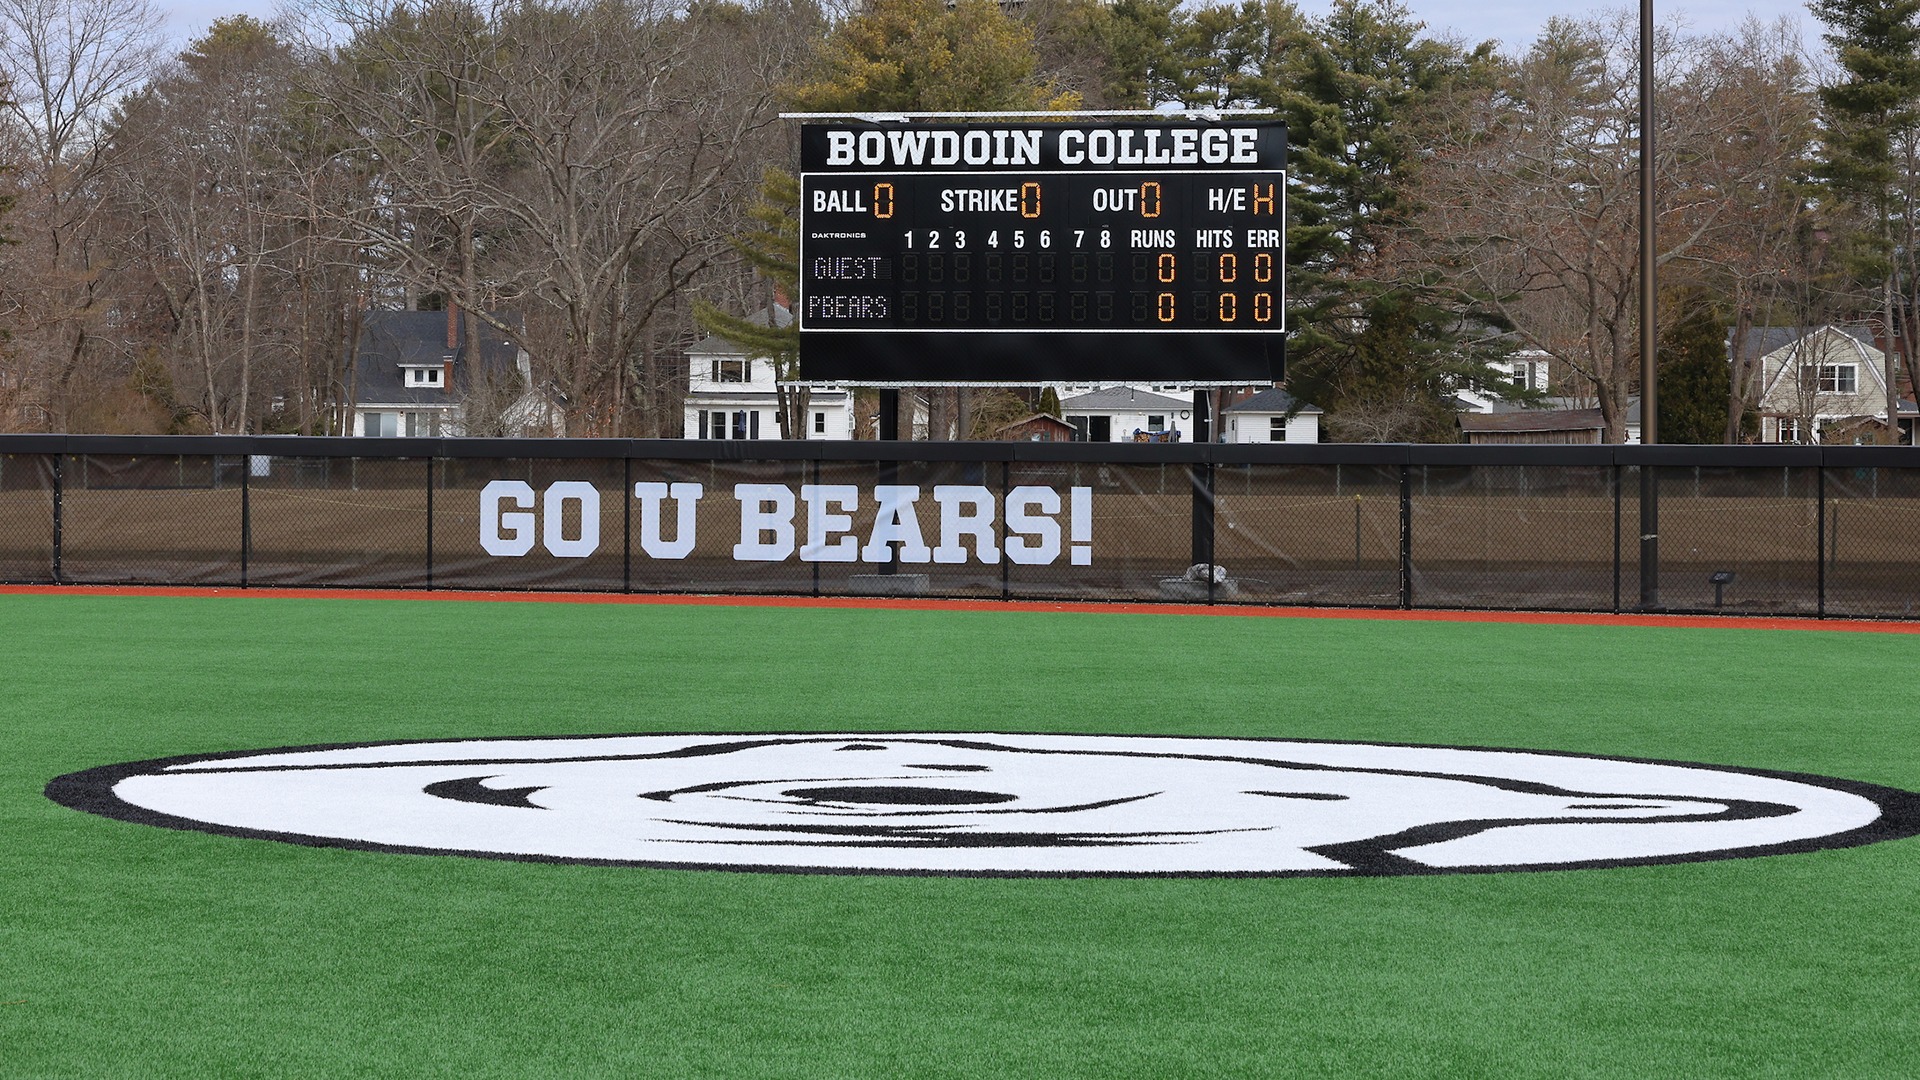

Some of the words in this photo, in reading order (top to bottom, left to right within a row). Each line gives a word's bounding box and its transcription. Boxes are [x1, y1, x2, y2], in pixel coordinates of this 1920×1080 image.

[826, 129, 1044, 166] BOWDOIN
[1058, 128, 1258, 165] COLLEGE
[813, 189, 867, 213] BALL
[874, 182, 894, 219] 0
[940, 189, 1018, 213] STRIKE
[1021, 182, 1041, 219] 0
[1092, 188, 1139, 212] OUT
[1140, 181, 1161, 218] 0
[1208, 187, 1246, 214] H/E
[1253, 183, 1274, 215] H
[904, 230, 913, 249] 1
[928, 230, 940, 249] 2
[955, 230, 966, 249] 3
[987, 230, 999, 249] 4
[1014, 230, 1025, 249] 5
[1040, 229, 1051, 249] 6
[1073, 230, 1085, 248] 7
[1100, 229, 1111, 249] 8
[1130, 229, 1176, 249] RUNS
[1196, 229, 1233, 249] HITS
[1247, 229, 1280, 248] ERR
[814, 256, 882, 280] GUEST
[1158, 253, 1175, 283] 0
[1219, 253, 1237, 283] 0
[1254, 253, 1272, 283] 0
[809, 295, 887, 319] PBEARS
[1158, 292, 1175, 322] 0
[1219, 292, 1237, 322] 0
[1254, 292, 1272, 322] 0
[479, 480, 600, 558] GO
[634, 481, 703, 560] U
[733, 483, 1092, 566] BEARS!
